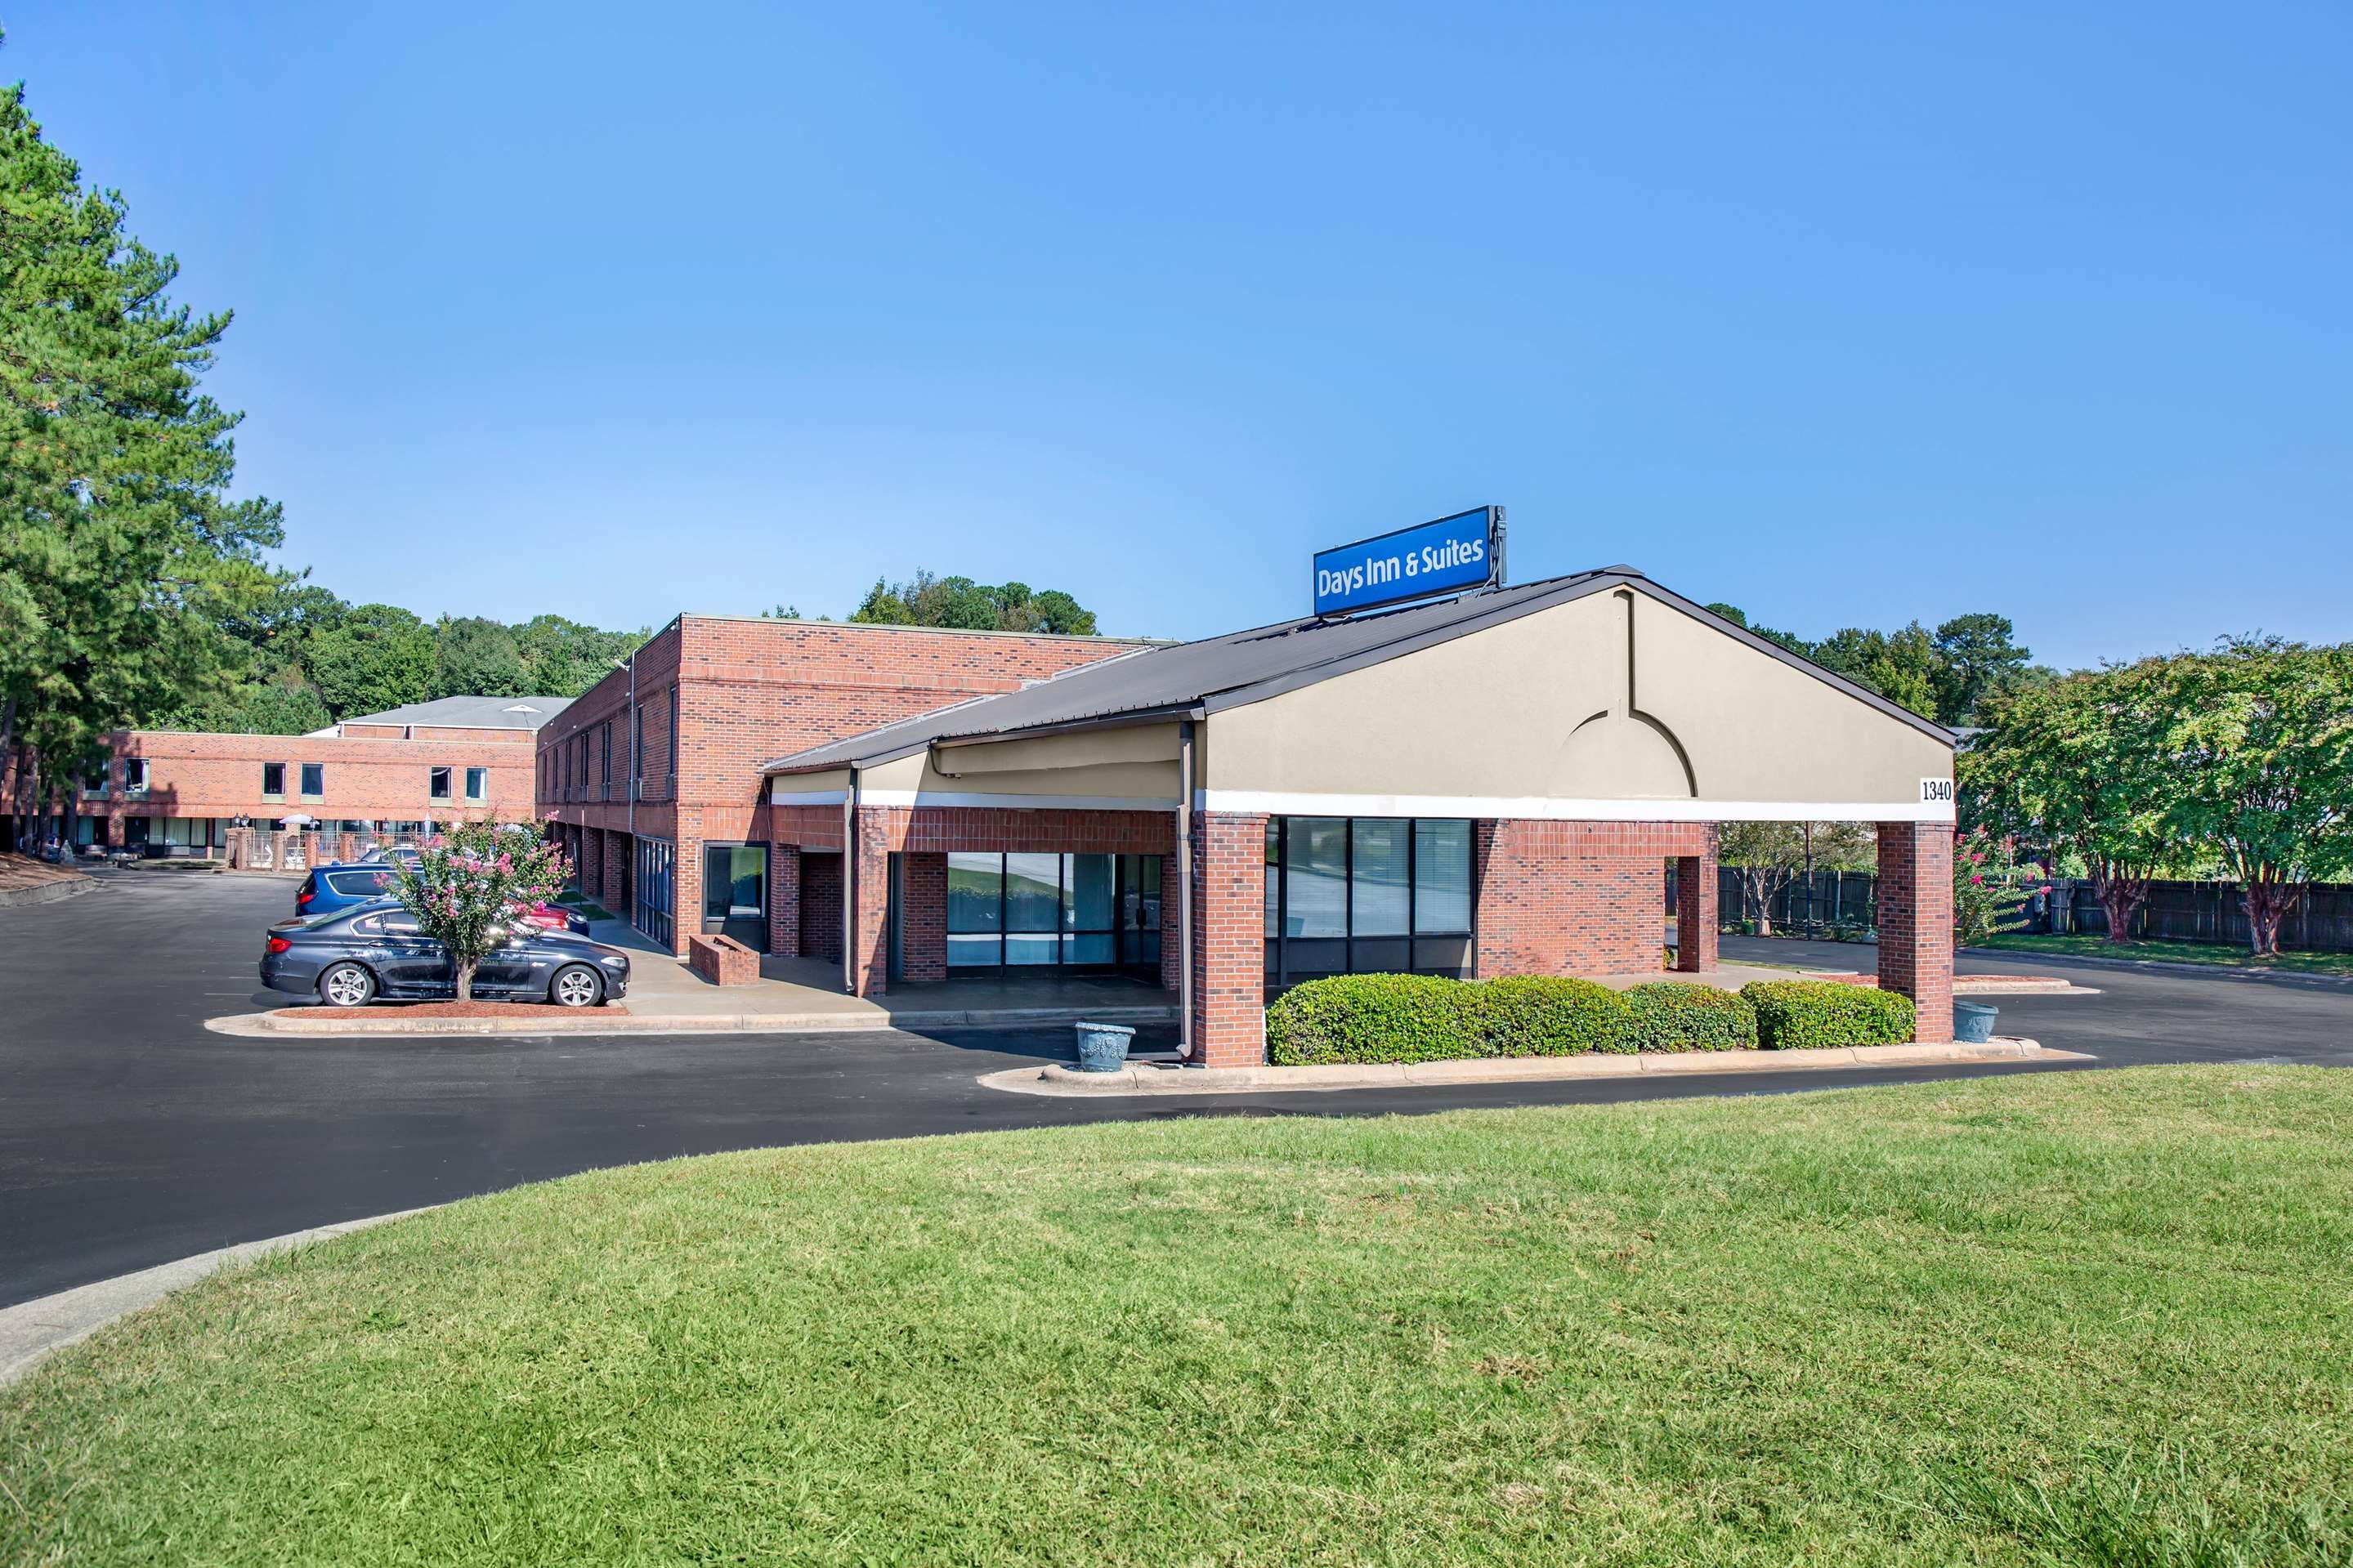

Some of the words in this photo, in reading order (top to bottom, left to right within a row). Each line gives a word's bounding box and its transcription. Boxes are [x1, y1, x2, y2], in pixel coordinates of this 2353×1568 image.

[1318, 565, 1363, 597] Days
[1367, 557, 1400, 586] Inn
[1405, 552, 1419, 577] &
[1422, 538, 1484, 574] Suites
[1923, 781, 1952, 800] 1340
